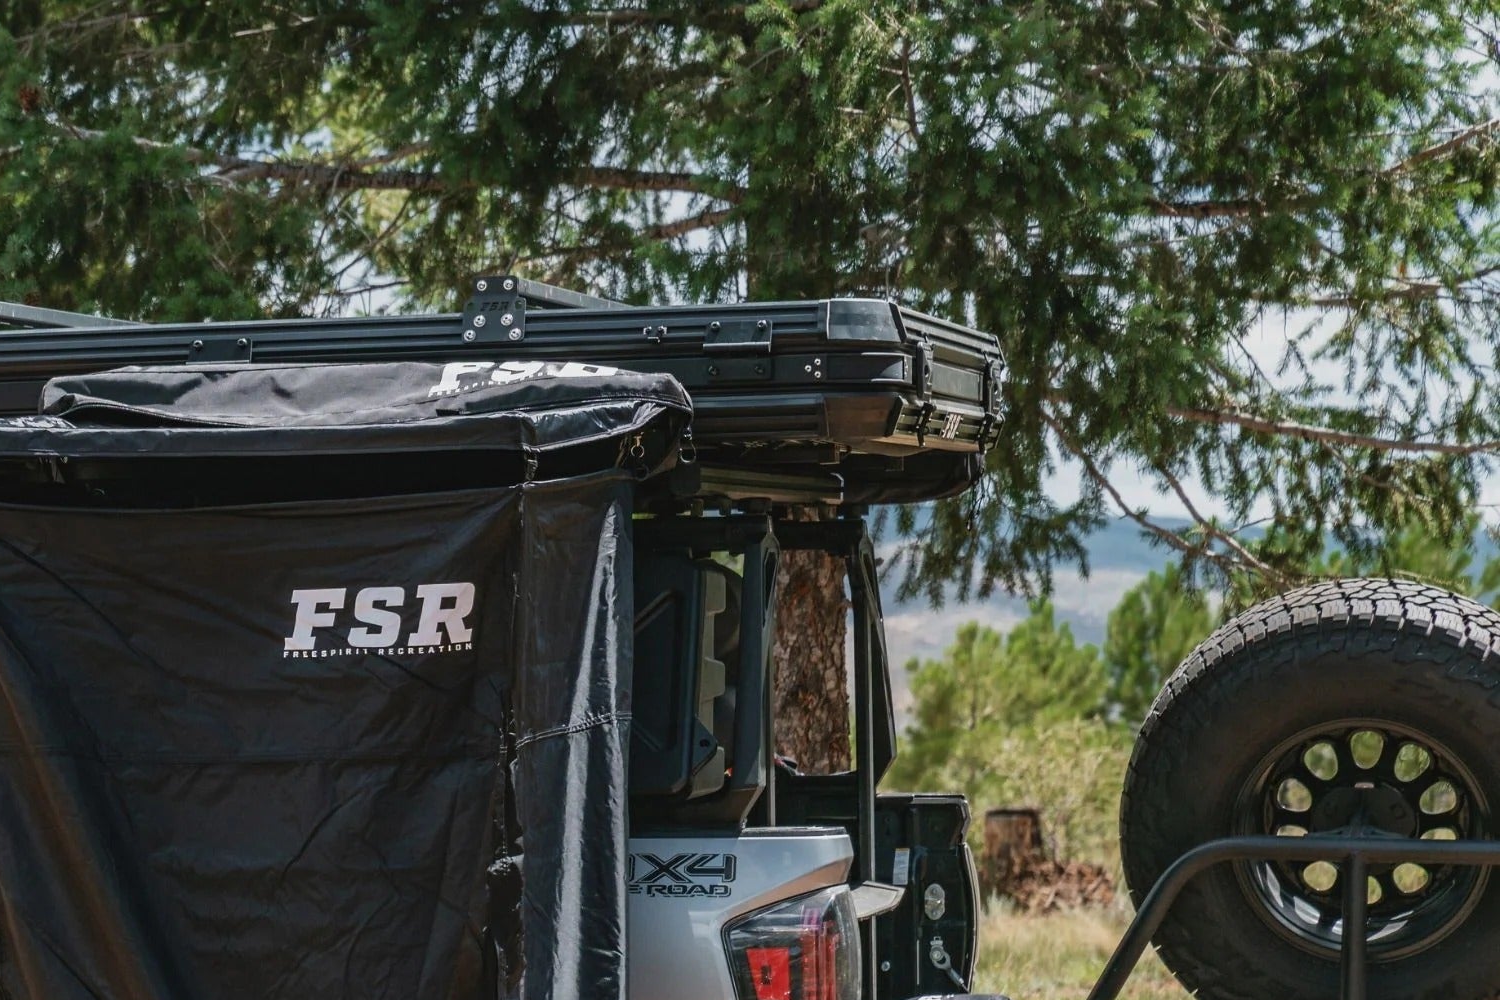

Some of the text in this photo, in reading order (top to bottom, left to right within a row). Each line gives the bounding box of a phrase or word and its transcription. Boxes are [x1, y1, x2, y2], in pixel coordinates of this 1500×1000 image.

[284, 582, 476, 650] FSR
[378, 642, 473, 656] RECREATION
[628, 852, 738, 884] X4
[647, 884, 732, 898] ROAD
